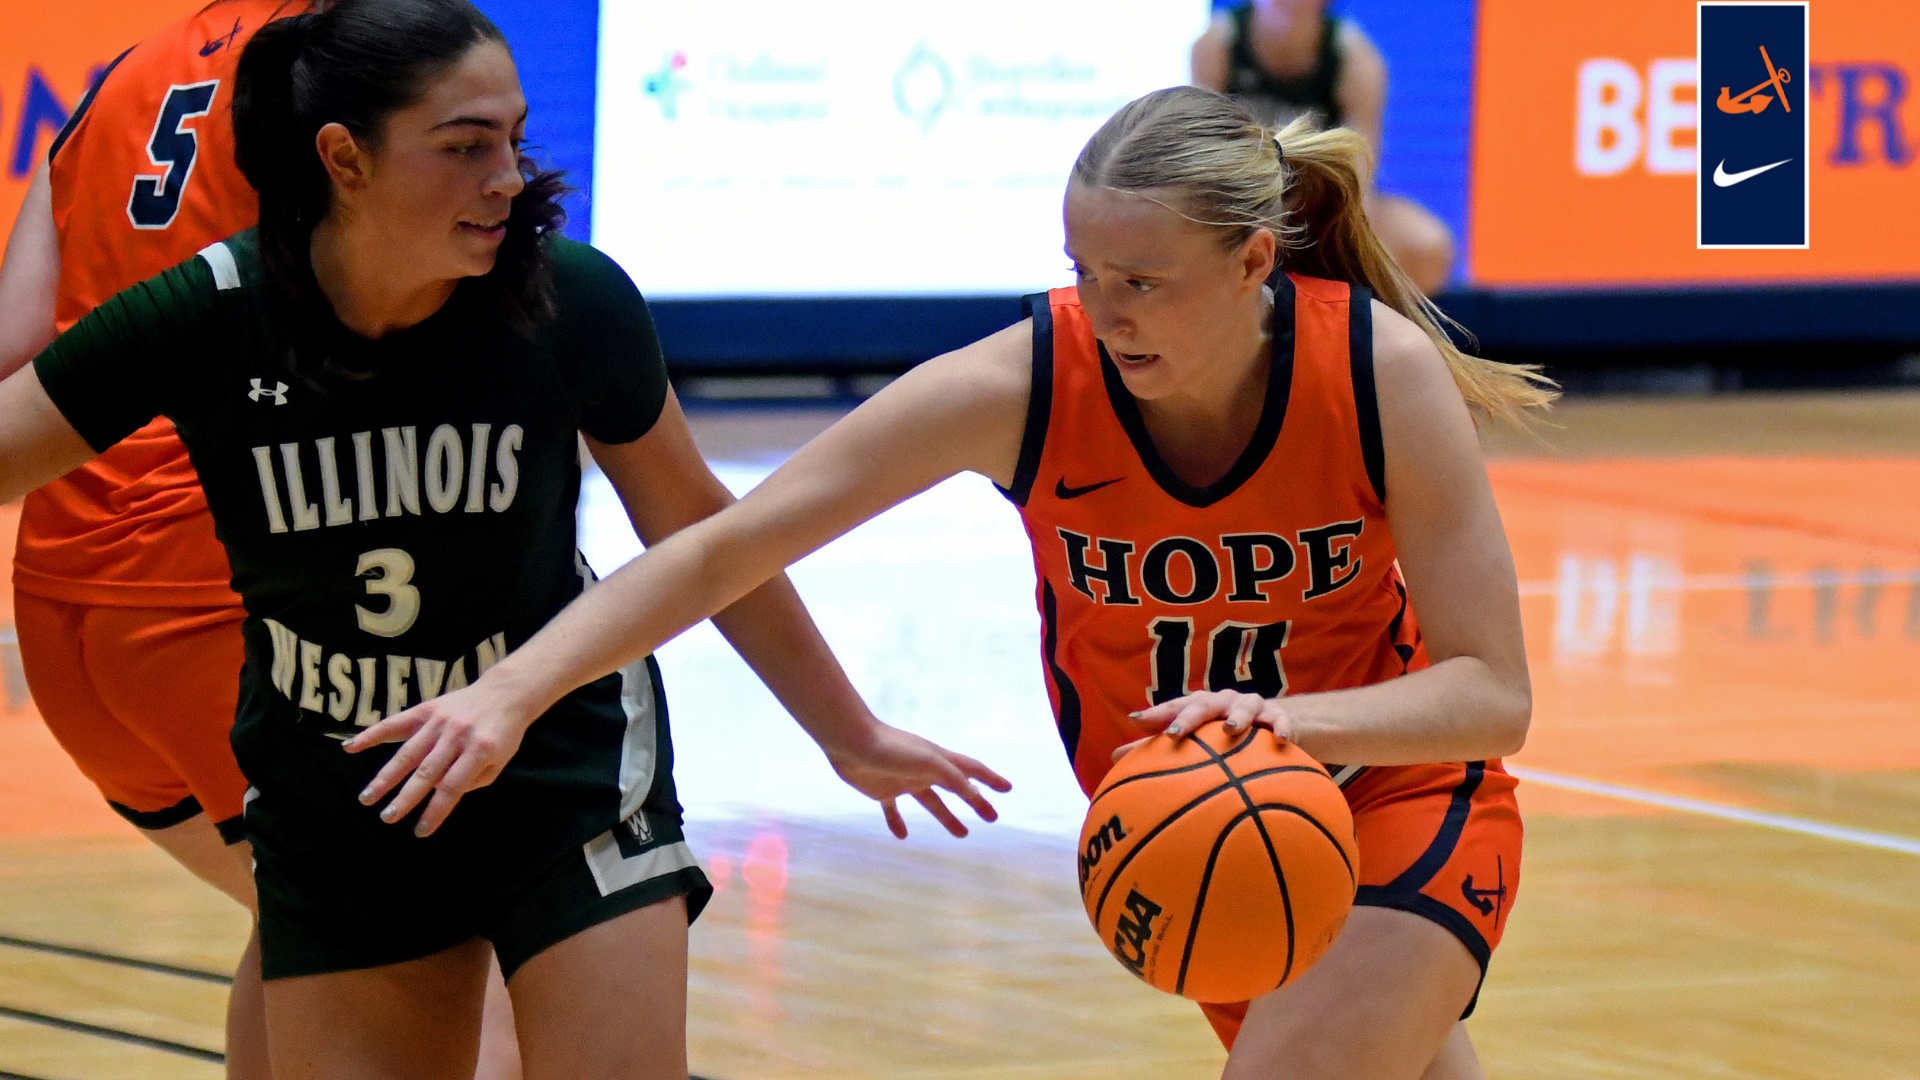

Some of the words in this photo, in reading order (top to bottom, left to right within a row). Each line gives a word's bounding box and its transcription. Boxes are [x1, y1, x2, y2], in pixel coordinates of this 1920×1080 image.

[126, 79, 220, 230] 5
[251, 423, 524, 533] ILLINOIS
[354, 548, 421, 638] 3
[1056, 516, 1365, 606] HOPE
